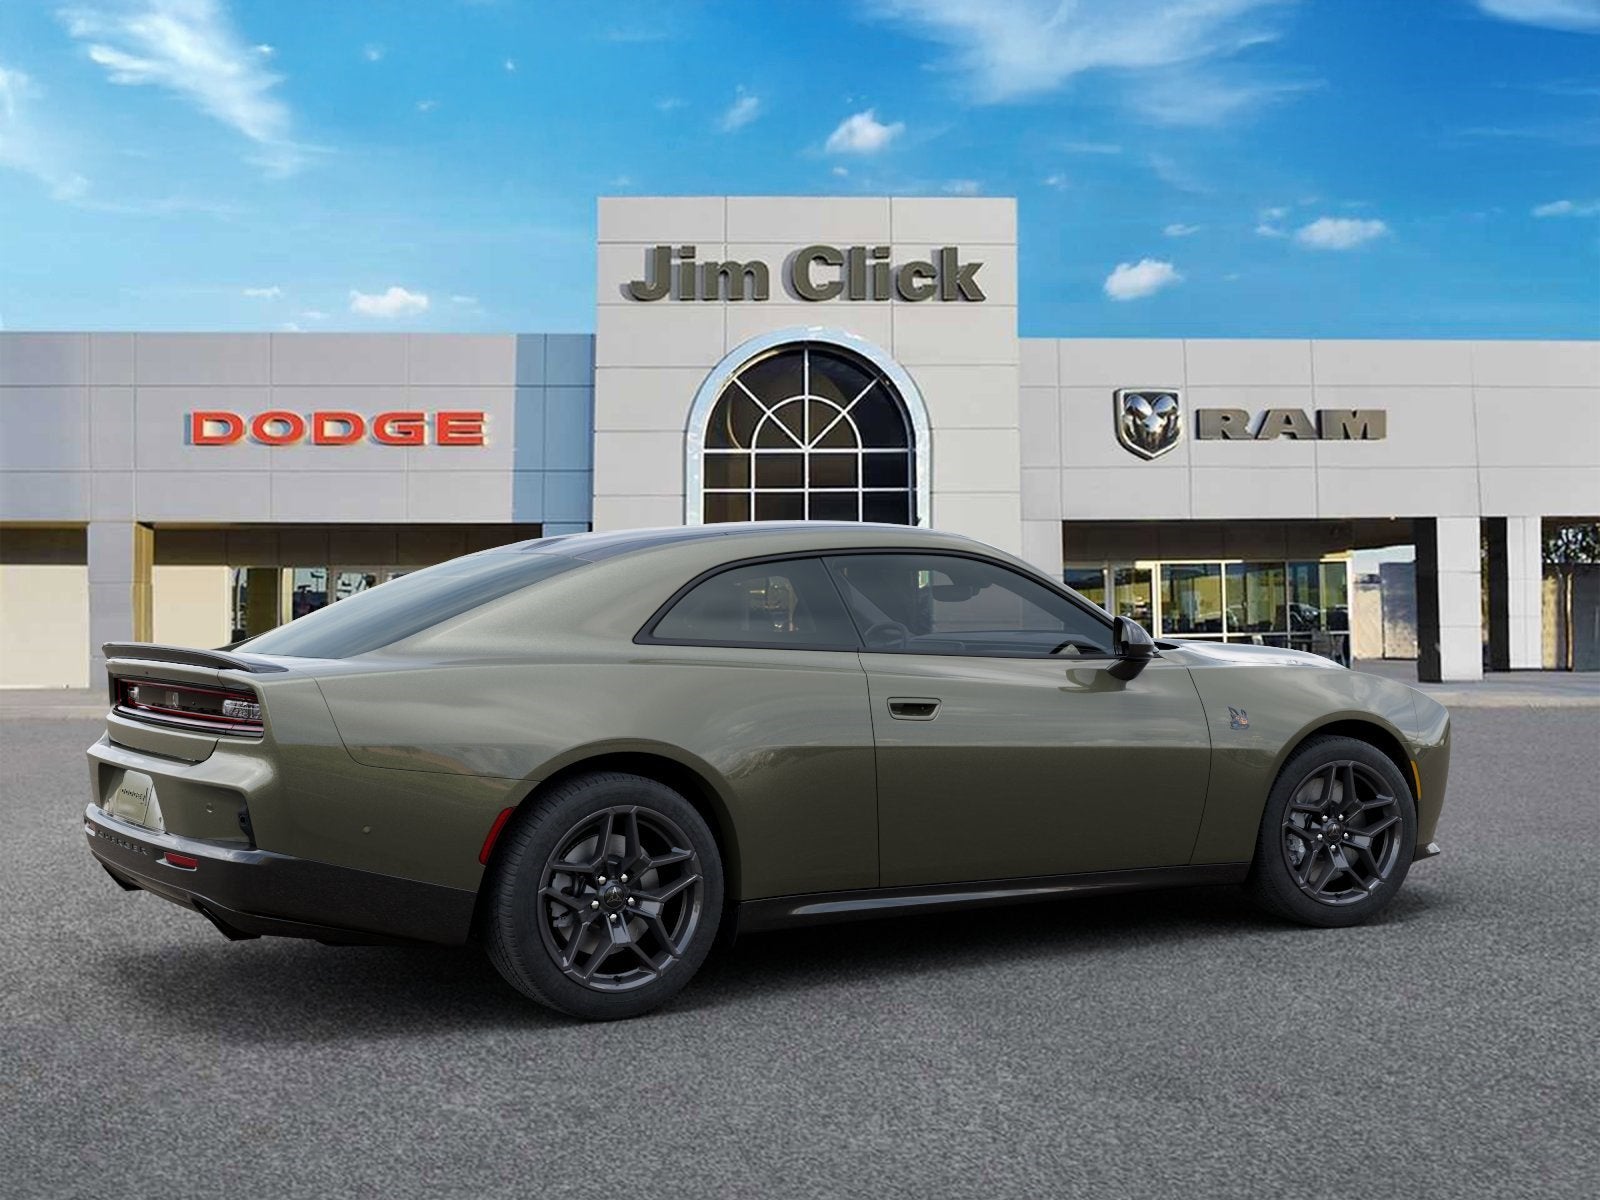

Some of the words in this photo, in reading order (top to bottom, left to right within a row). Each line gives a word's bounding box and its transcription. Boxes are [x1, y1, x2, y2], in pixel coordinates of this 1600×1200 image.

[628, 245, 769, 301] Jim
[792, 245, 986, 301] Click
[192, 410, 485, 446] DODGE
[1195, 408, 1387, 440] RAM
